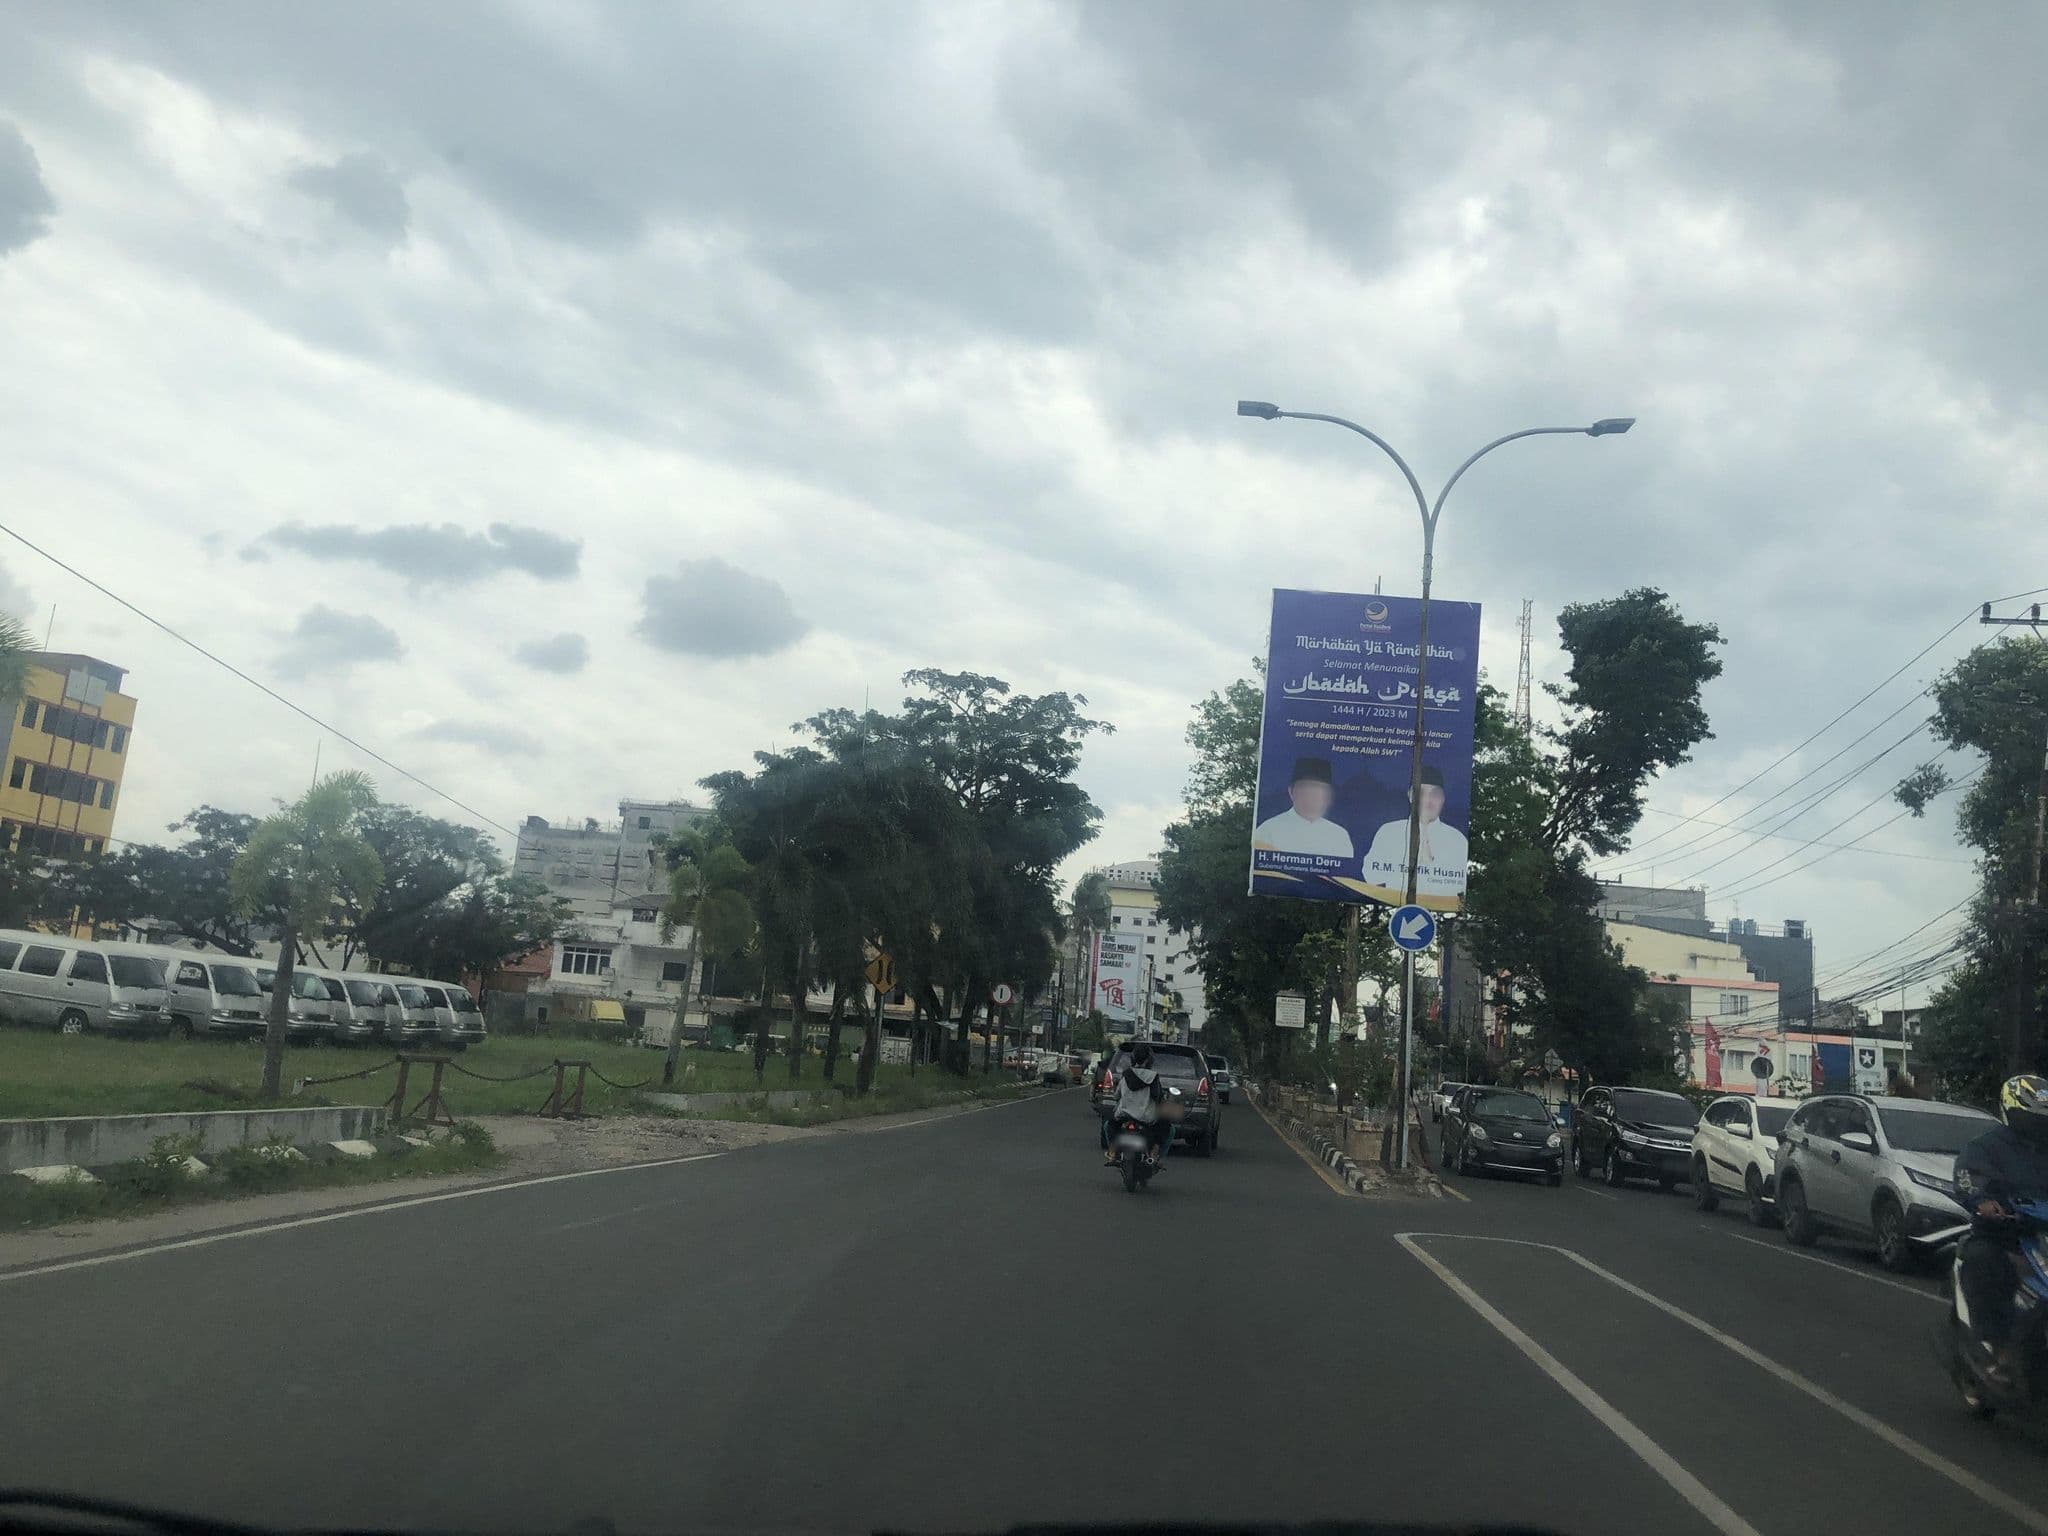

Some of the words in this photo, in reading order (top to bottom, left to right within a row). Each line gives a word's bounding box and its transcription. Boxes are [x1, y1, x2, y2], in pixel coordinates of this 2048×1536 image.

[1323, 658, 1363, 671] Selamat
[1332, 705, 1355, 715] 1444
[1357, 706, 1364, 716] H
[1366, 706, 1371, 717] /
[1373, 707, 1396, 718] 2023
[1398, 709, 1408, 719] M
[1320, 721, 1360, 732] Ramadhan
[1362, 724, 1384, 733] tahun
[1385, 726, 1395, 735] ini
[1396, 727, 1427, 737] berjan
[1429, 730, 1453, 739] lancar
[1295, 731, 1314, 739] serta
[1315, 731, 1337, 741] dapat
[1339, 734, 1386, 744] memperkuat
[1426, 740, 1441, 749] kita
[1331, 743, 1359, 753] kepada
[1360, 746, 1380, 755] Allah
[1258, 851, 1270, 861] H.
[1272, 852, 1313, 865] Herman
[1316, 856, 1341, 868] Deru
[1371, 861, 1395, 873] R.M.
[1399, 863, 1430, 876] Tafik
[1433, 866, 1465, 878] Husni
